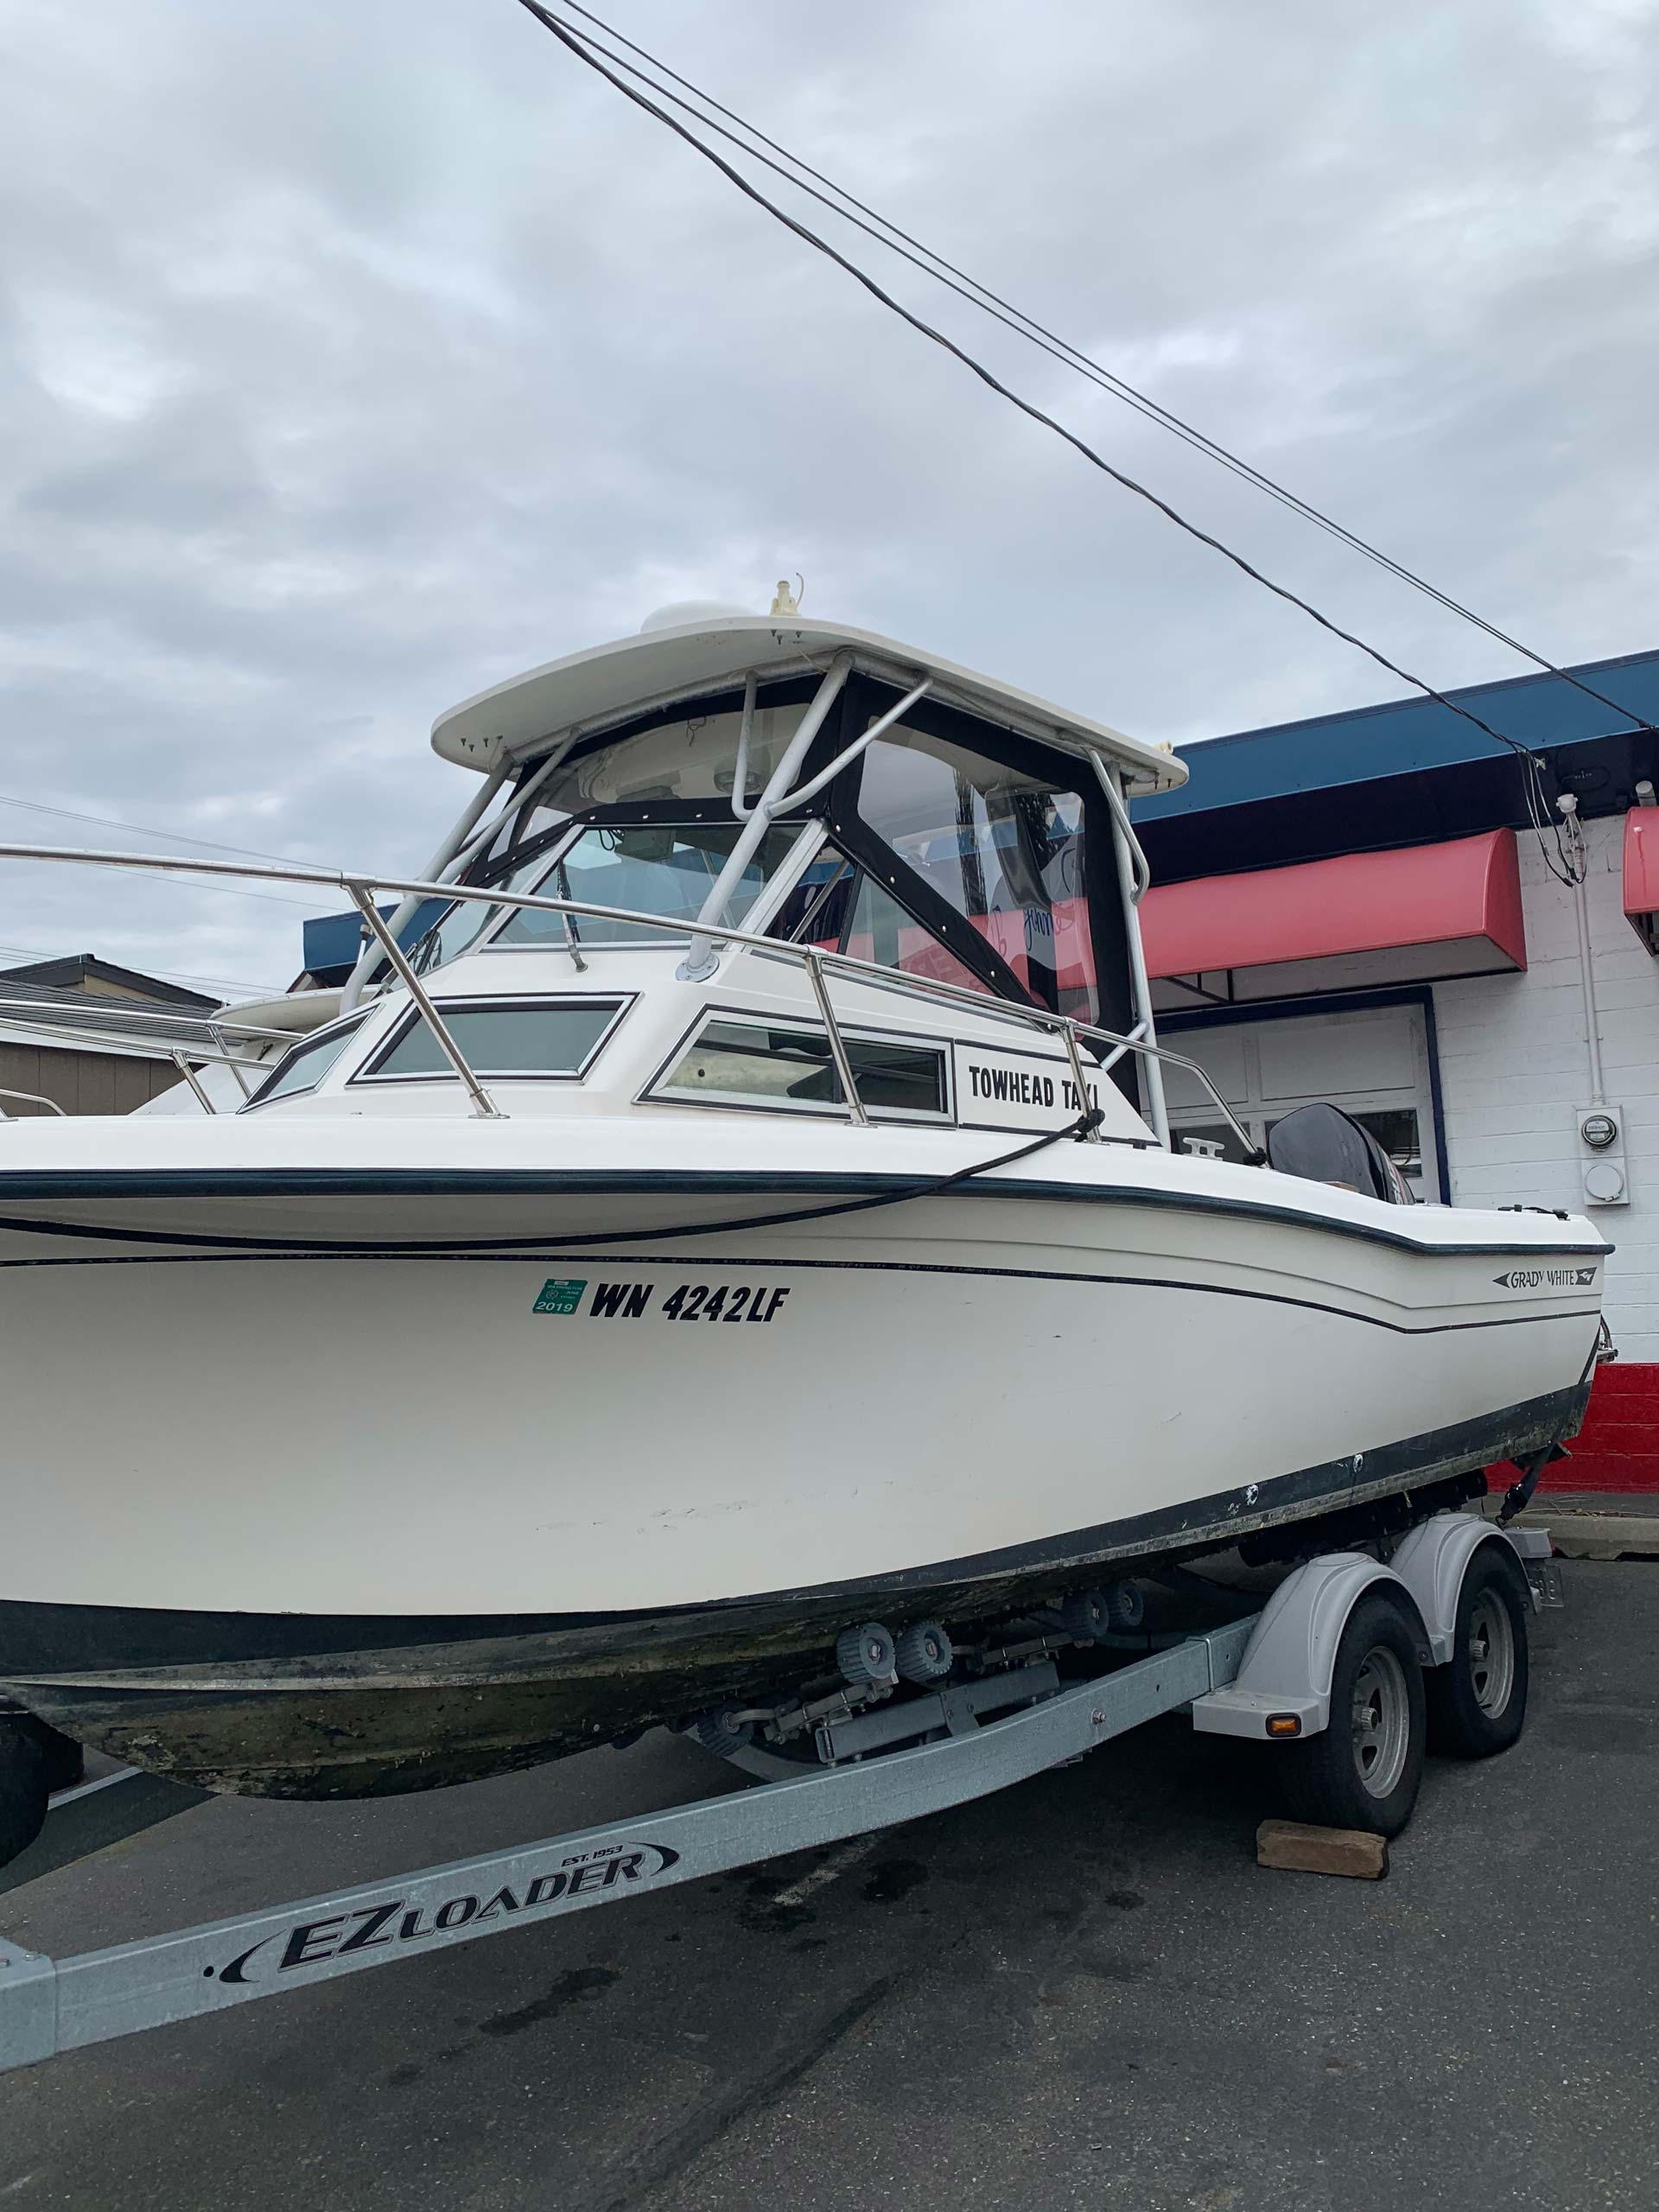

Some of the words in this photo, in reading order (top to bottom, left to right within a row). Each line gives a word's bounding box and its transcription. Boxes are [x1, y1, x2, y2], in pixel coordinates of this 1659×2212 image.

[969, 1065, 1054, 1107] TOWHEAD
[1510, 1270, 1545, 1288] GRADY
[1547, 1269, 1574, 1286] WHITE
[535, 1301, 574, 1313] 2019
[589, 1283, 654, 1318] WN
[662, 1285, 791, 1322] 4242LF
[562, 1853, 589, 1866] EST.
[593, 1845, 623, 1859] 1953
